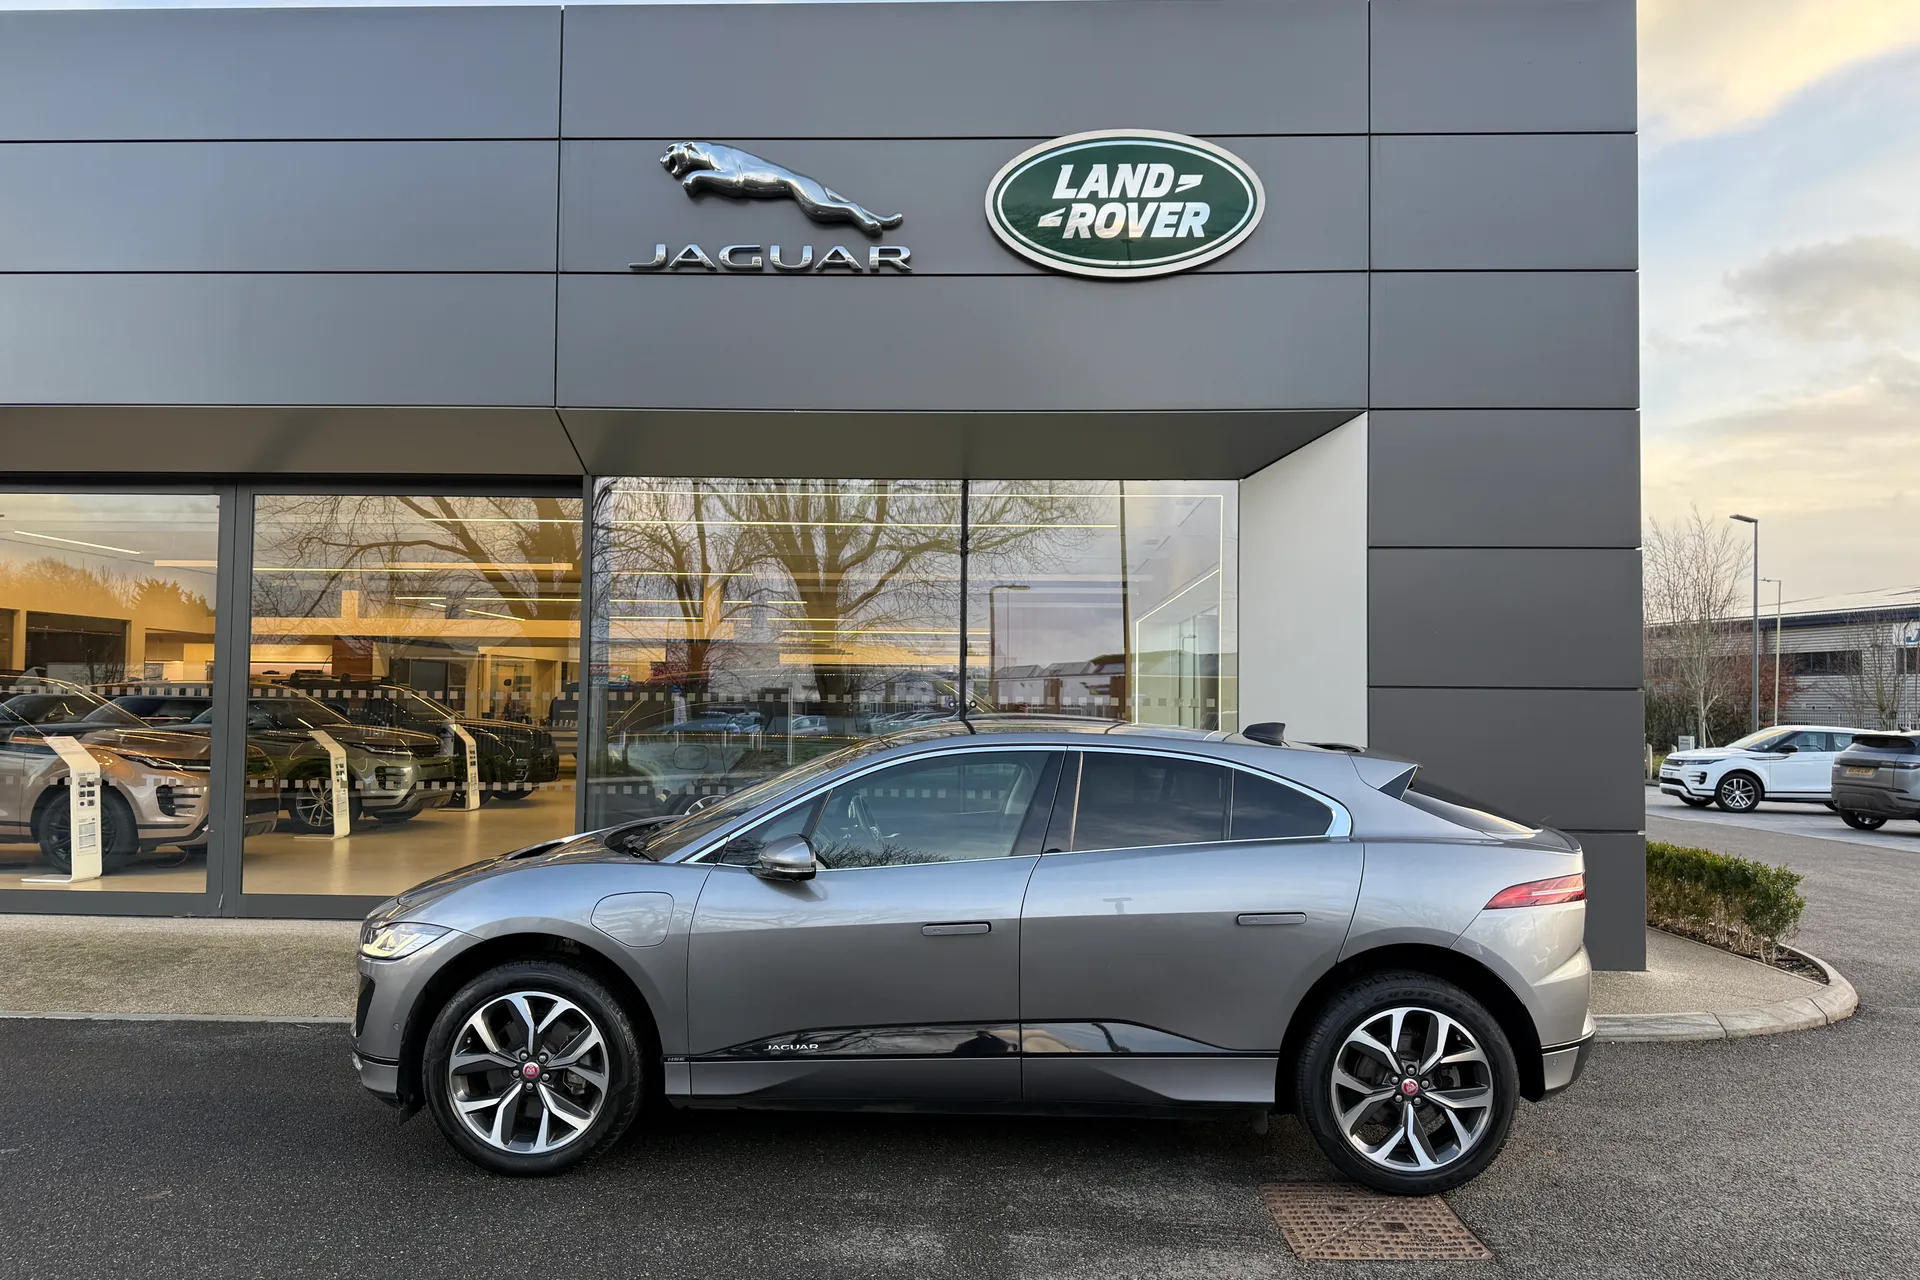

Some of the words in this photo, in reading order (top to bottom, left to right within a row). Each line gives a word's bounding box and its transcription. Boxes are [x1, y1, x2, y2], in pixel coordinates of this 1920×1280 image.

[1052, 163, 1175, 199] LAND
[1062, 202, 1211, 239] ROVER
[628, 243, 912, 271] JAGUAR
[766, 1043, 819, 1051] JAGUAR
